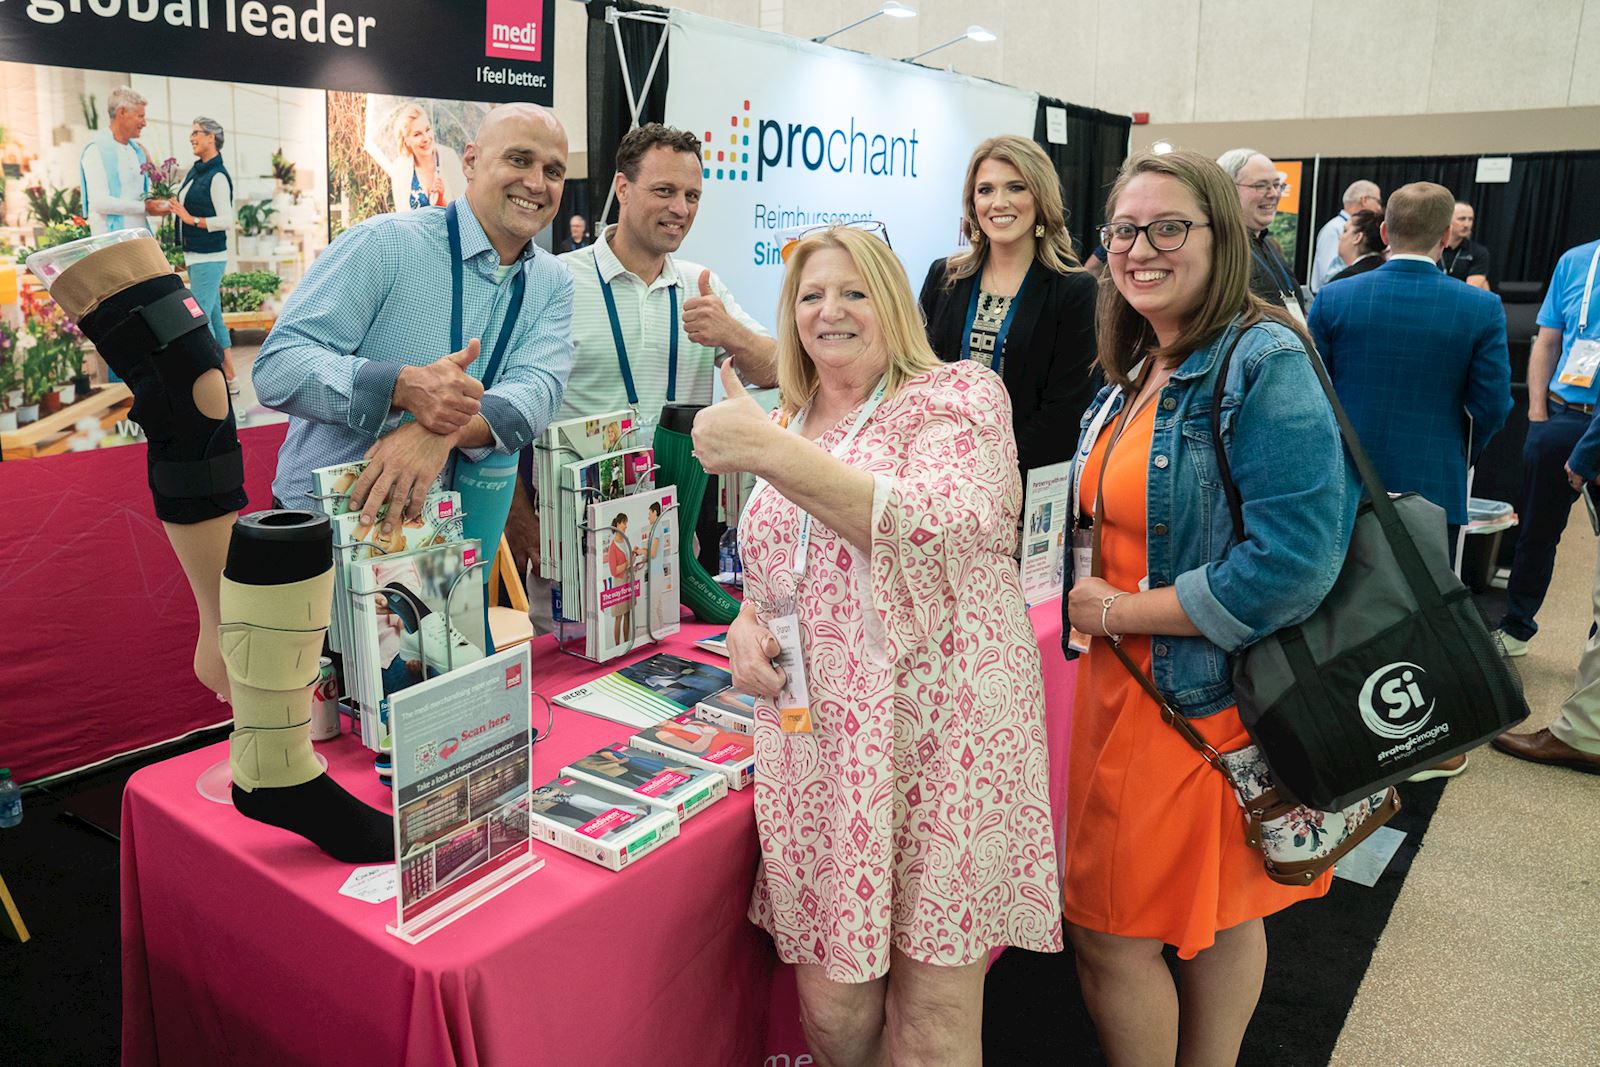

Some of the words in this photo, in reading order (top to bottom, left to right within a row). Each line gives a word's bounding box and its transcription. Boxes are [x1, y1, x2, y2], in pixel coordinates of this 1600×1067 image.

[26, 0, 209, 30] goal
[226, 0, 377, 48] leader
[492, 22, 537, 45] medi
[476, 66, 482, 82] I
[482, 66, 506, 84] feel
[507, 69, 547, 88] better.
[757, 116, 919, 182] prochant
[476, 481, 508, 491] cep
[687, 575, 717, 601] mediven
[716, 597, 731, 610] 550
[569, 688, 588, 699] cep
[1380, 670, 1426, 719] Si
[460, 723, 487, 742] Scan
[487, 713, 511, 729] here
[1377, 722, 1449, 761] strategicimaging
[416, 780, 432, 792] Take
[435, 774, 448, 785] look
[455, 762, 472, 775] these
[471, 751, 495, 767] updated
[495, 740, 515, 757] spaces!
[641, 772, 674, 793] mediven
[583, 810, 620, 833] mediven
